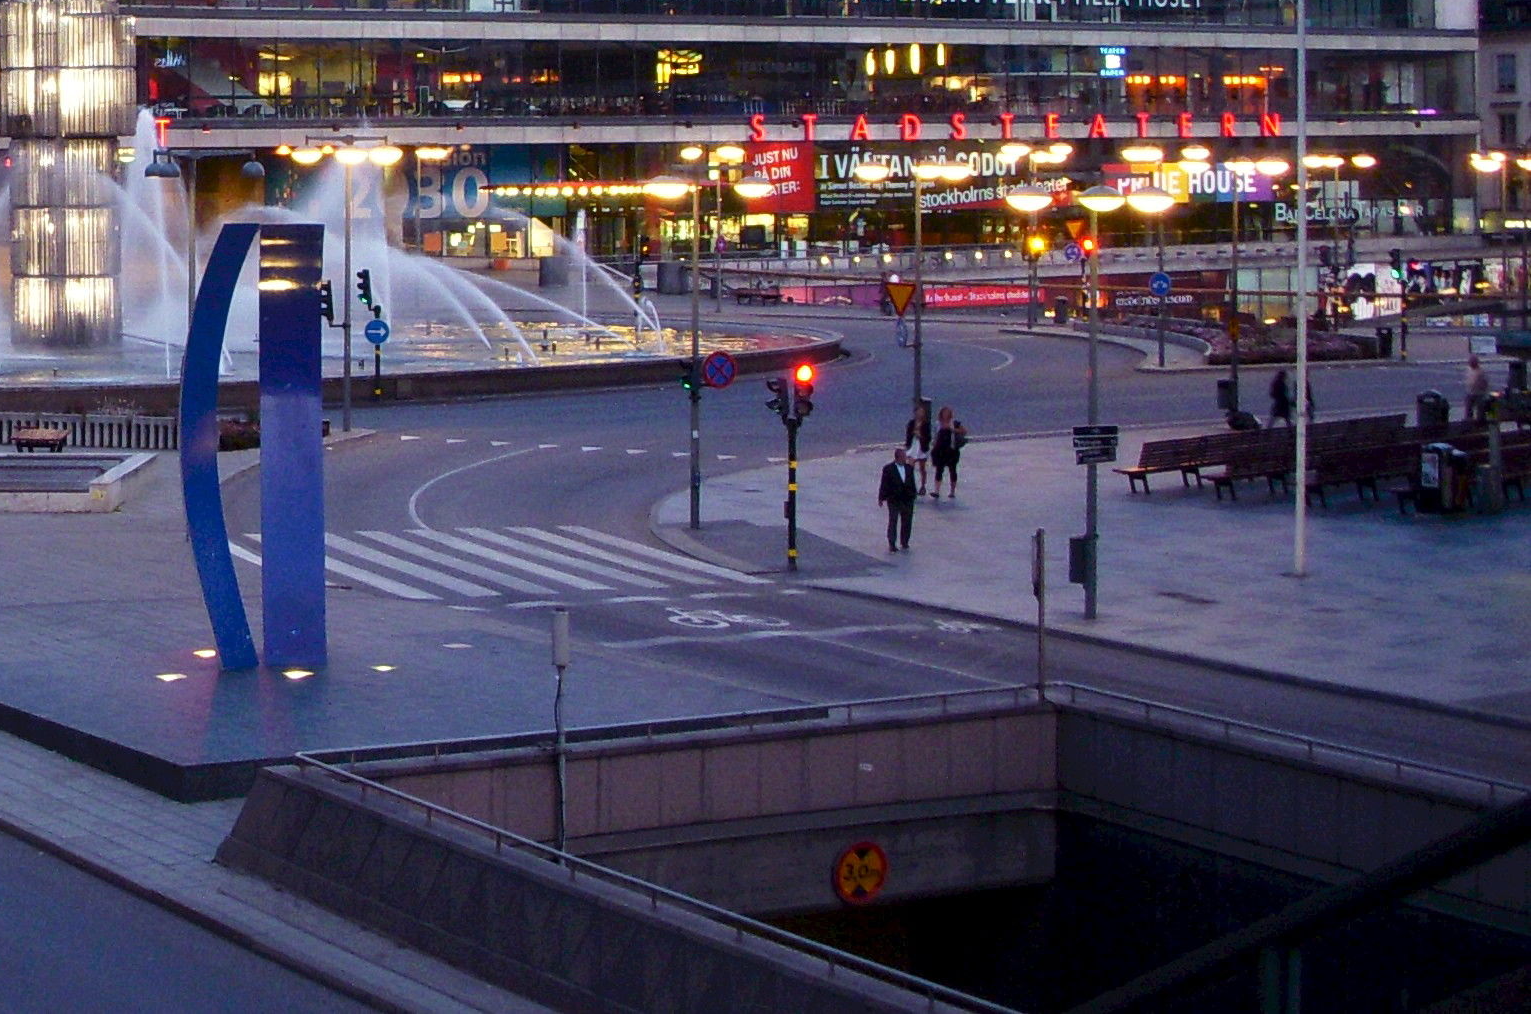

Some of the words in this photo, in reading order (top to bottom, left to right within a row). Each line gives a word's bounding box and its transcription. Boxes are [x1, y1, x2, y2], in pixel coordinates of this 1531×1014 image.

[749, 112, 1283, 142] STADSTEATERN
[752, 150, 779, 166] JUST
[781, 147, 798, 161] NU
[820, 154, 829, 179] I
[754, 166, 770, 180] PÅ
[771, 165, 792, 180] DIN
[1189, 169, 1257, 194] HOUSE
[920, 184, 994, 208] stockholms
